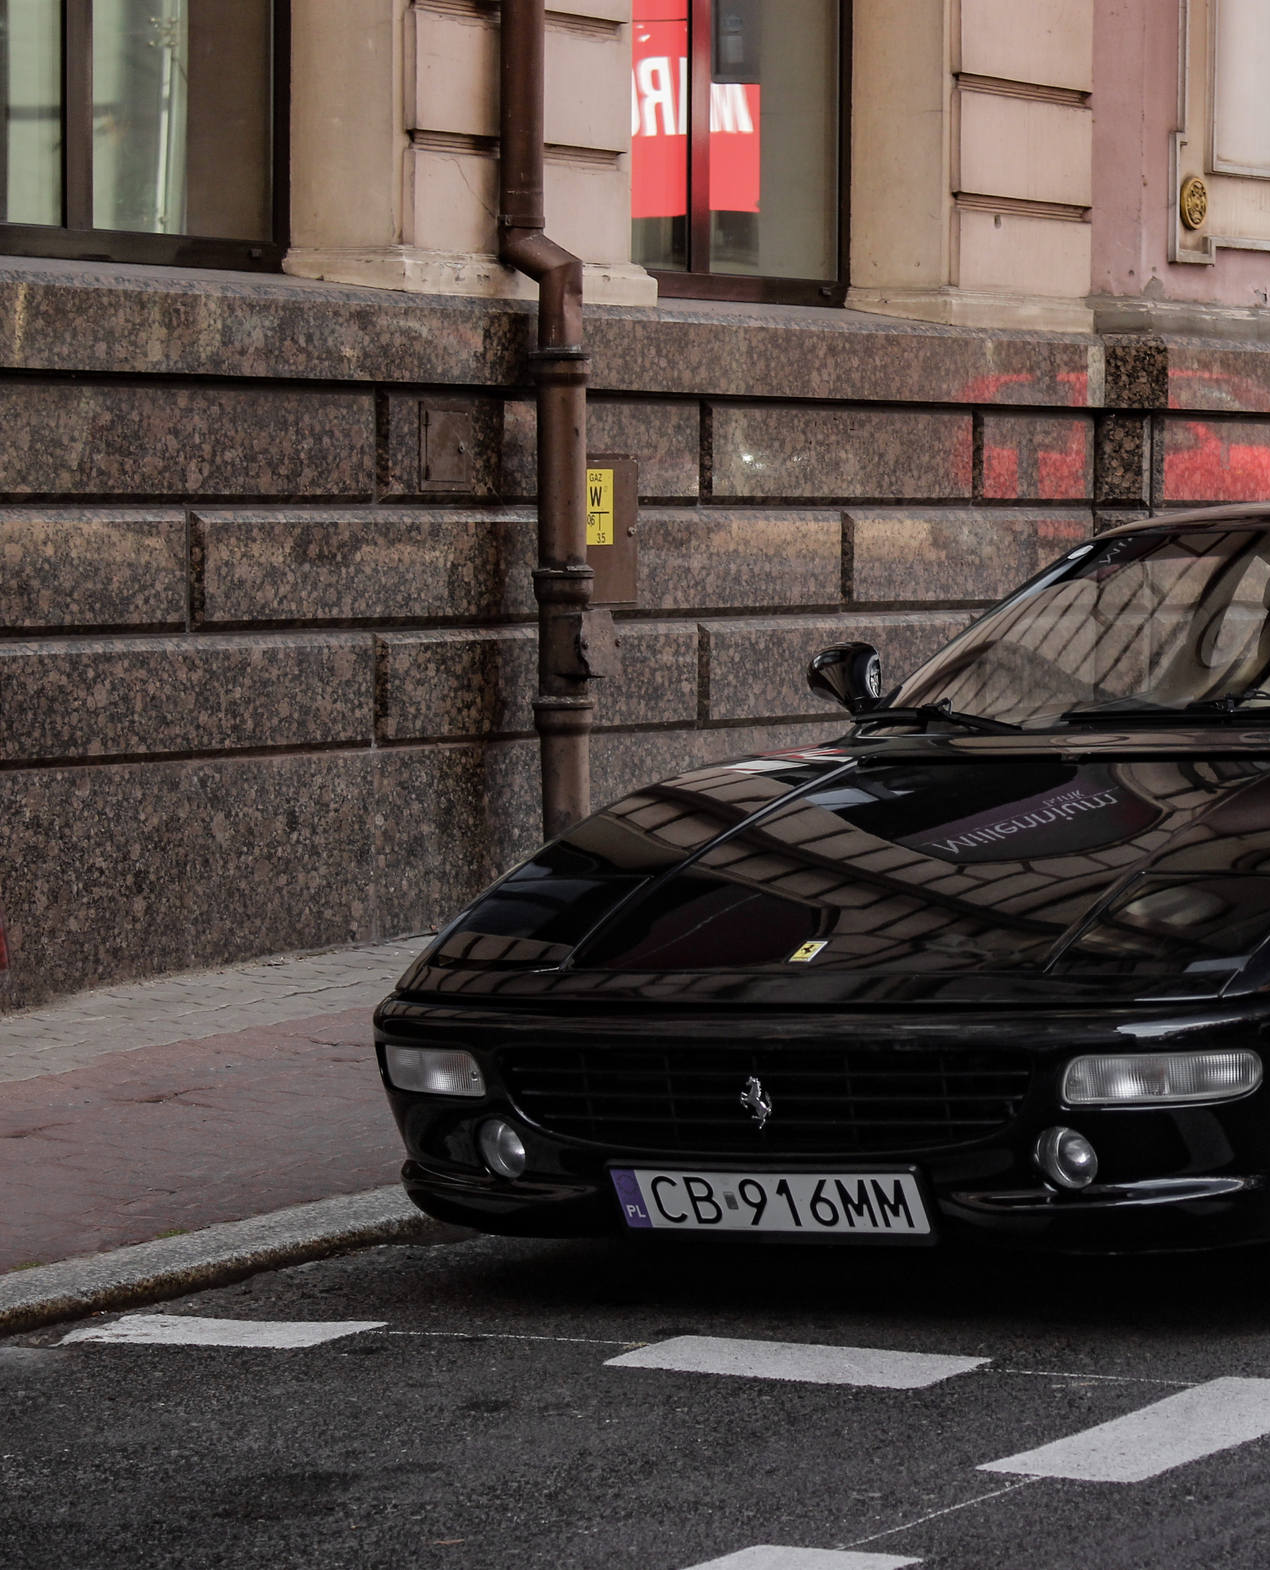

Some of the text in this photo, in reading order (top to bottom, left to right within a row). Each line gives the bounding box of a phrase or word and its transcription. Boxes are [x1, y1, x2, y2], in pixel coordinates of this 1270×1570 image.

[589, 473, 602, 482] GAZ
[589, 486, 602, 507] W
[650, 1175, 916, 1229] CB 916MM
[625, 1204, 646, 1218] PL
